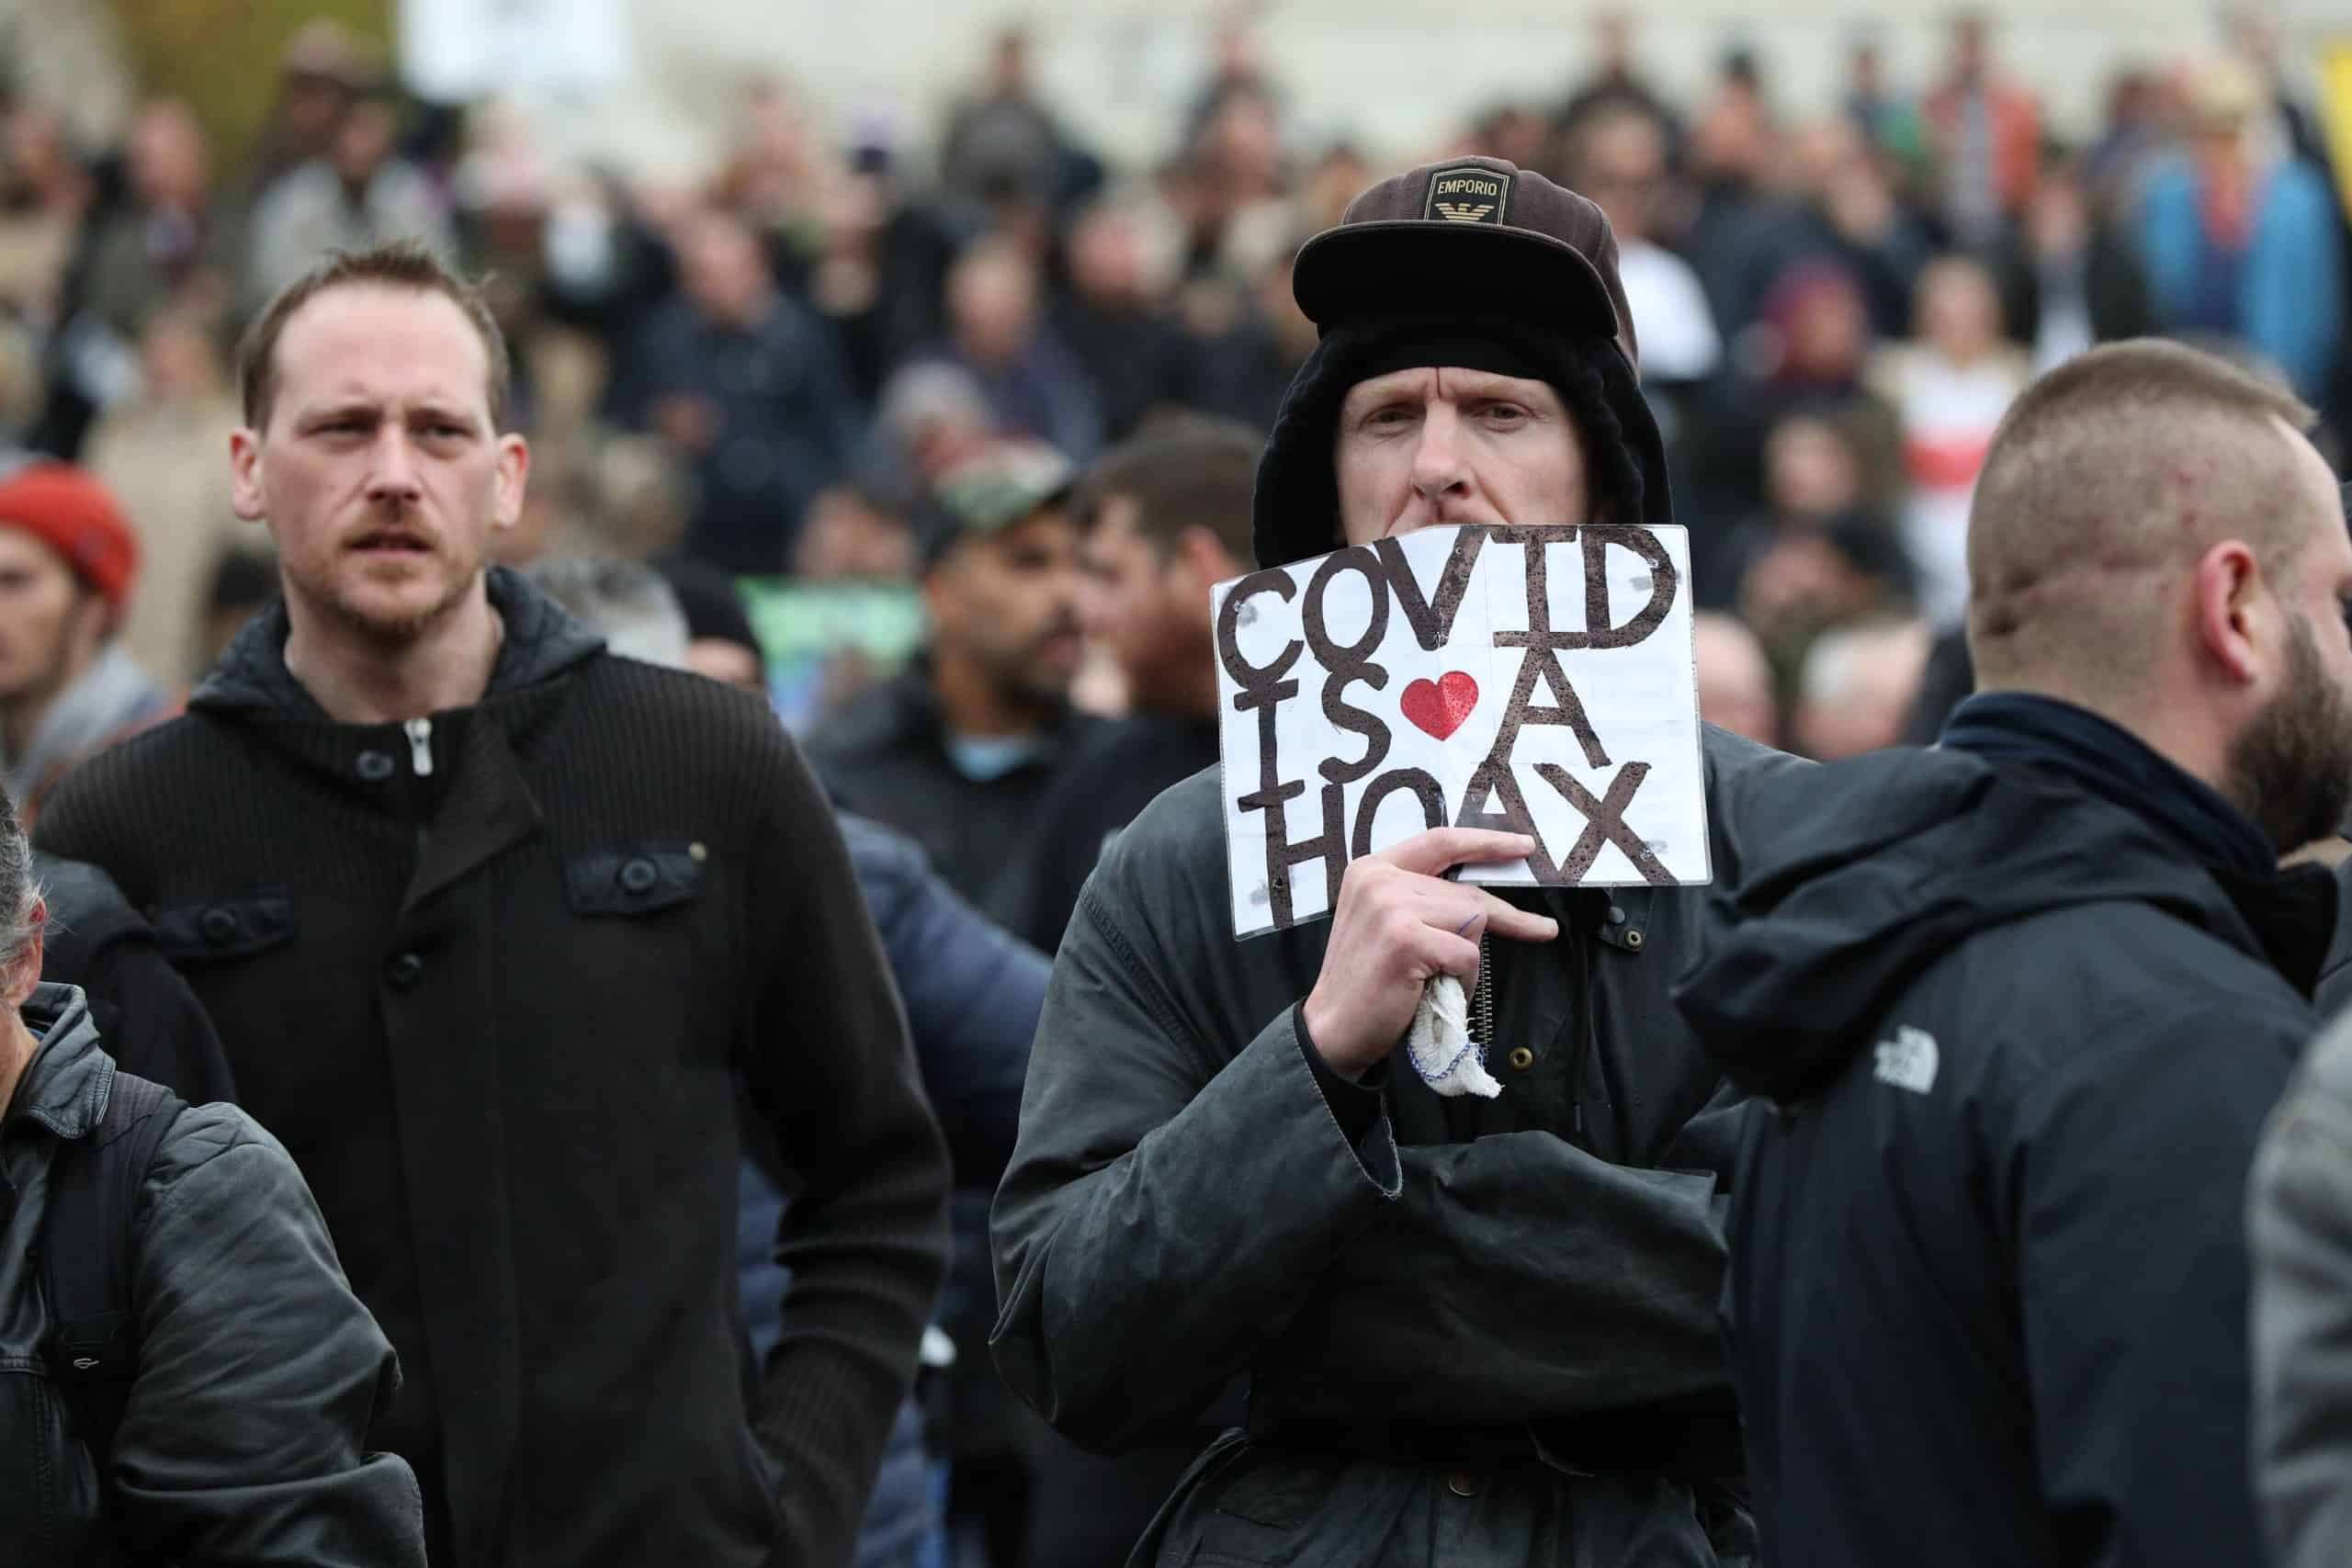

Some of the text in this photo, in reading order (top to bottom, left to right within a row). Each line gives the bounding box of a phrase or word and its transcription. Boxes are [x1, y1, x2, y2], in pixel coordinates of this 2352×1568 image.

[1437, 179, 1498, 197] EMPORIO
[1217, 525, 1678, 689] COVID
[1234, 647, 1612, 813] IS A
[1263, 761, 1680, 929] HOAX
